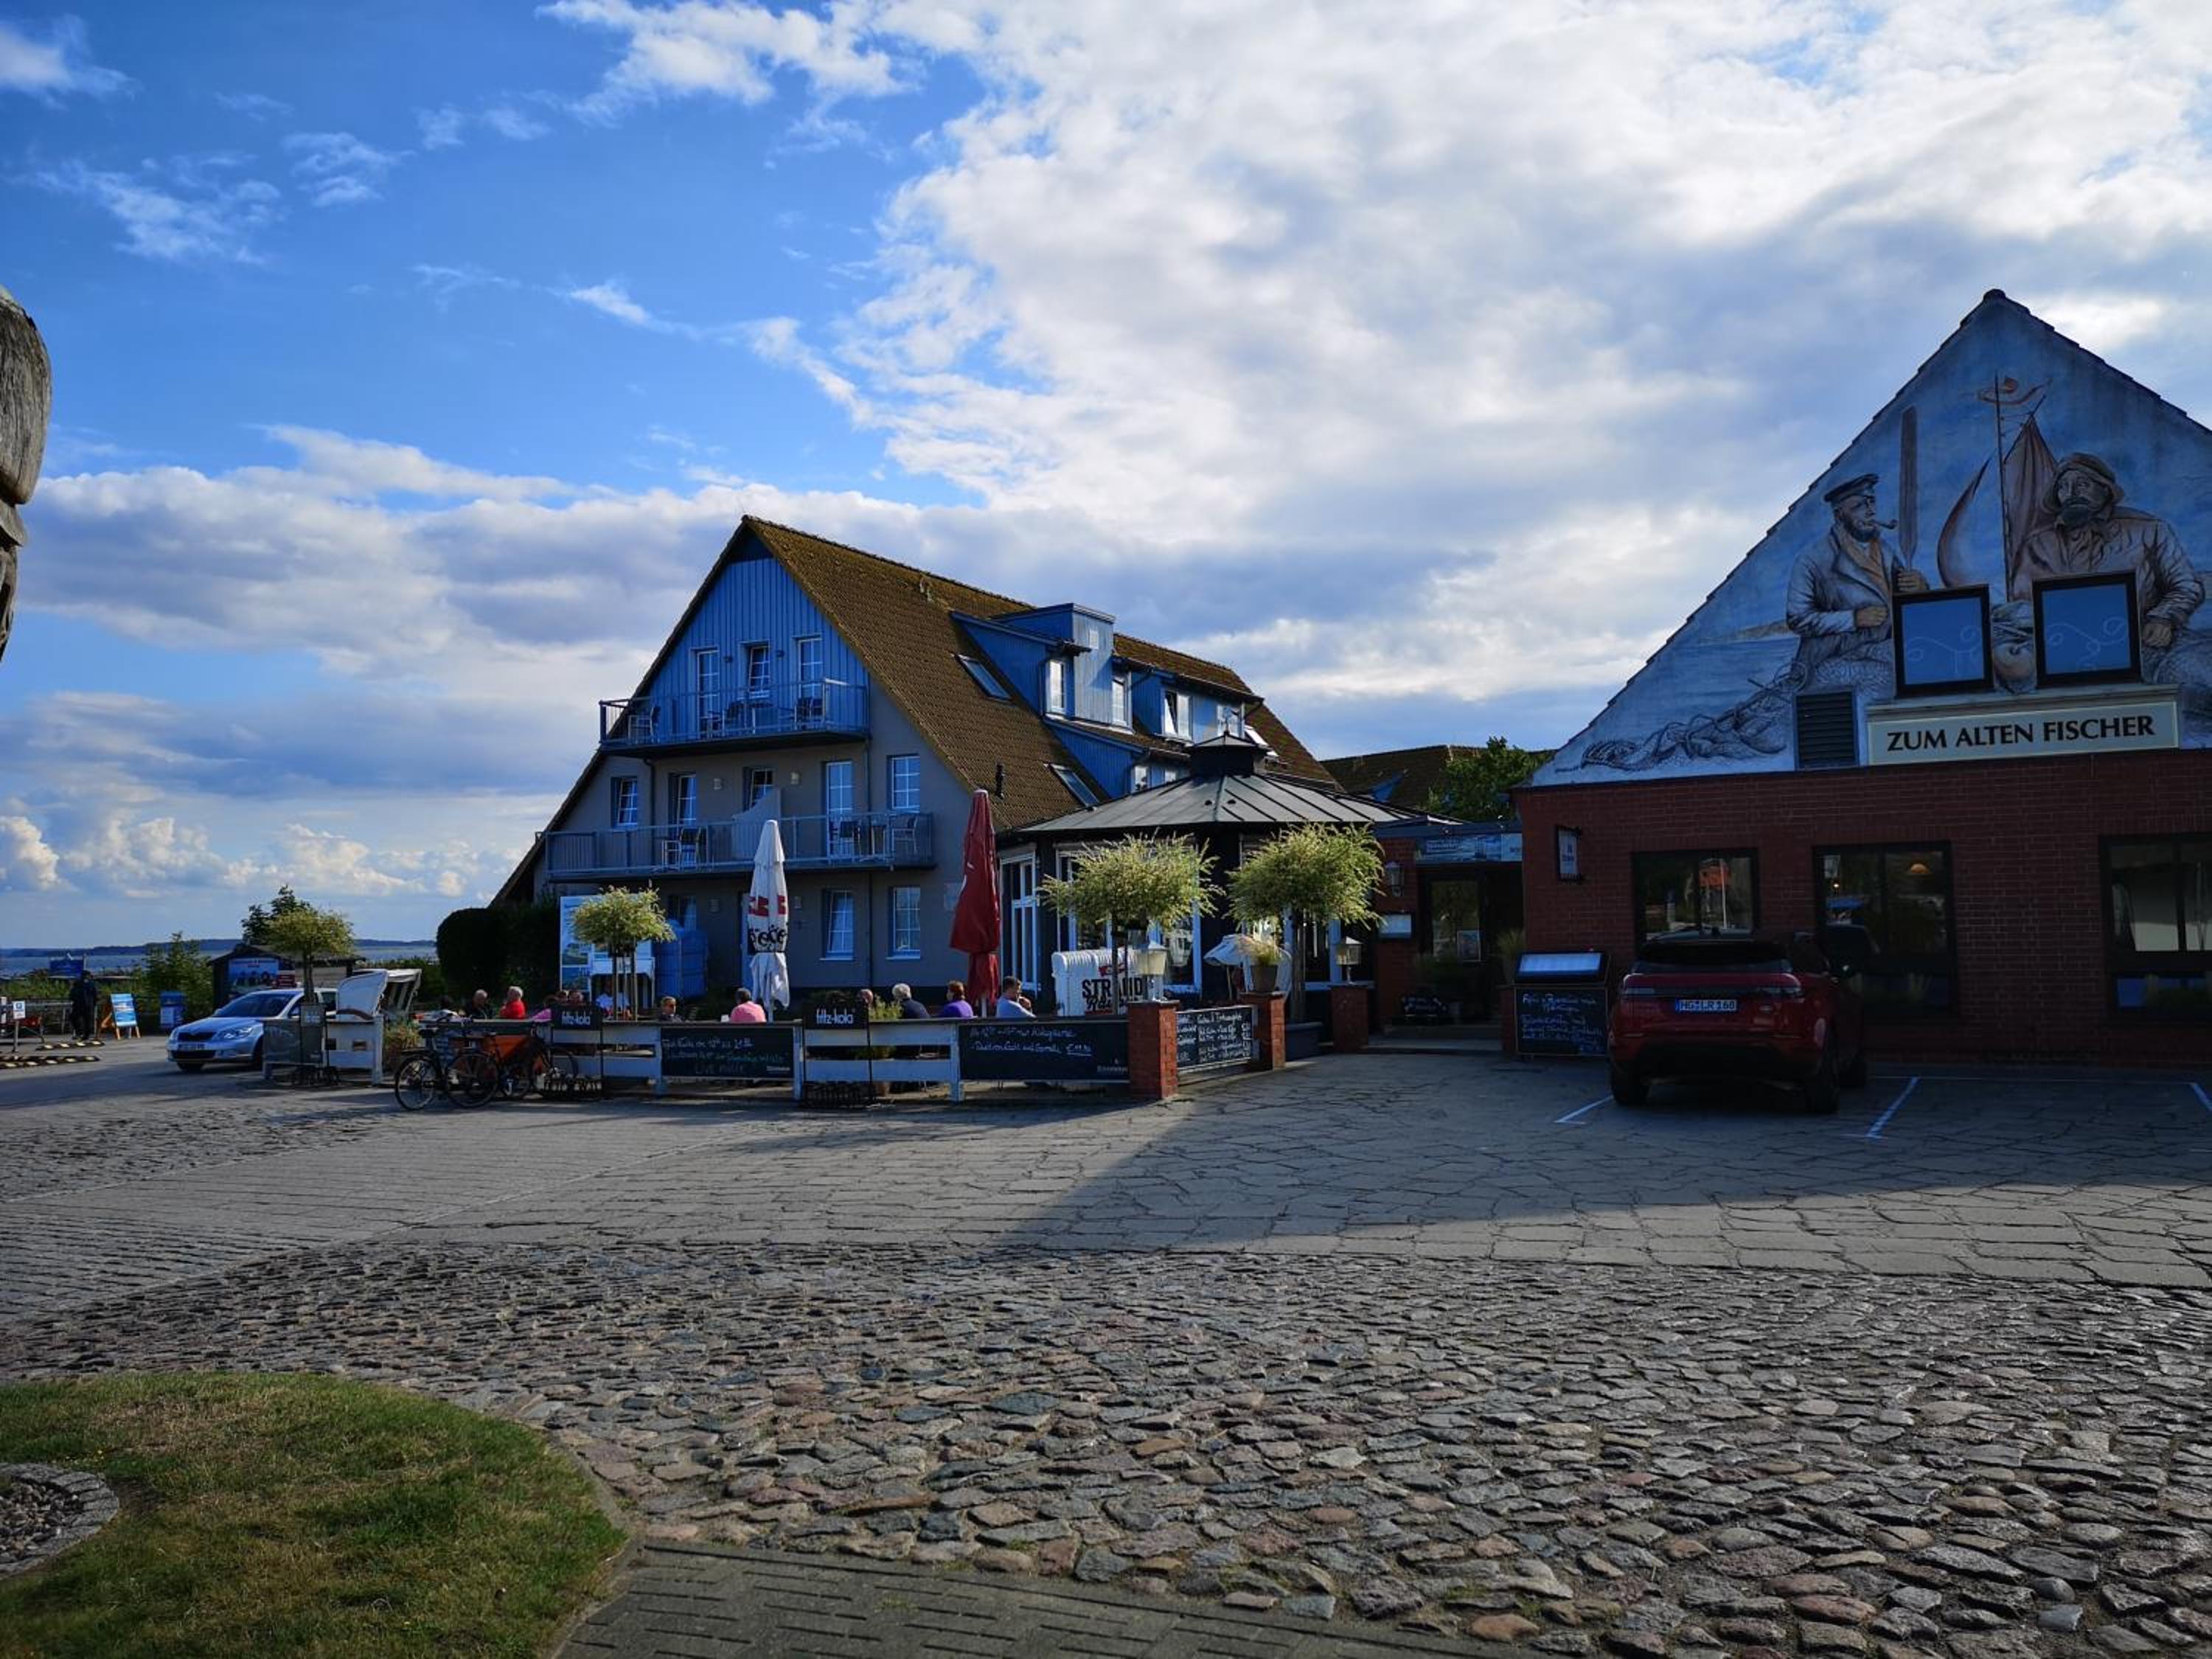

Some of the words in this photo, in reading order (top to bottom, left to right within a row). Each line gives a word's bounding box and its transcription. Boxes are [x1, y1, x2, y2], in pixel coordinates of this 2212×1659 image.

[1886, 728, 1947, 751] ZUM
[1955, 723, 2034, 748] ALTEN
[2042, 715, 2155, 742] FISCHER
[561, 1011, 591, 1026] fritz-kola
[815, 1008, 853, 1025] fritz-kola
